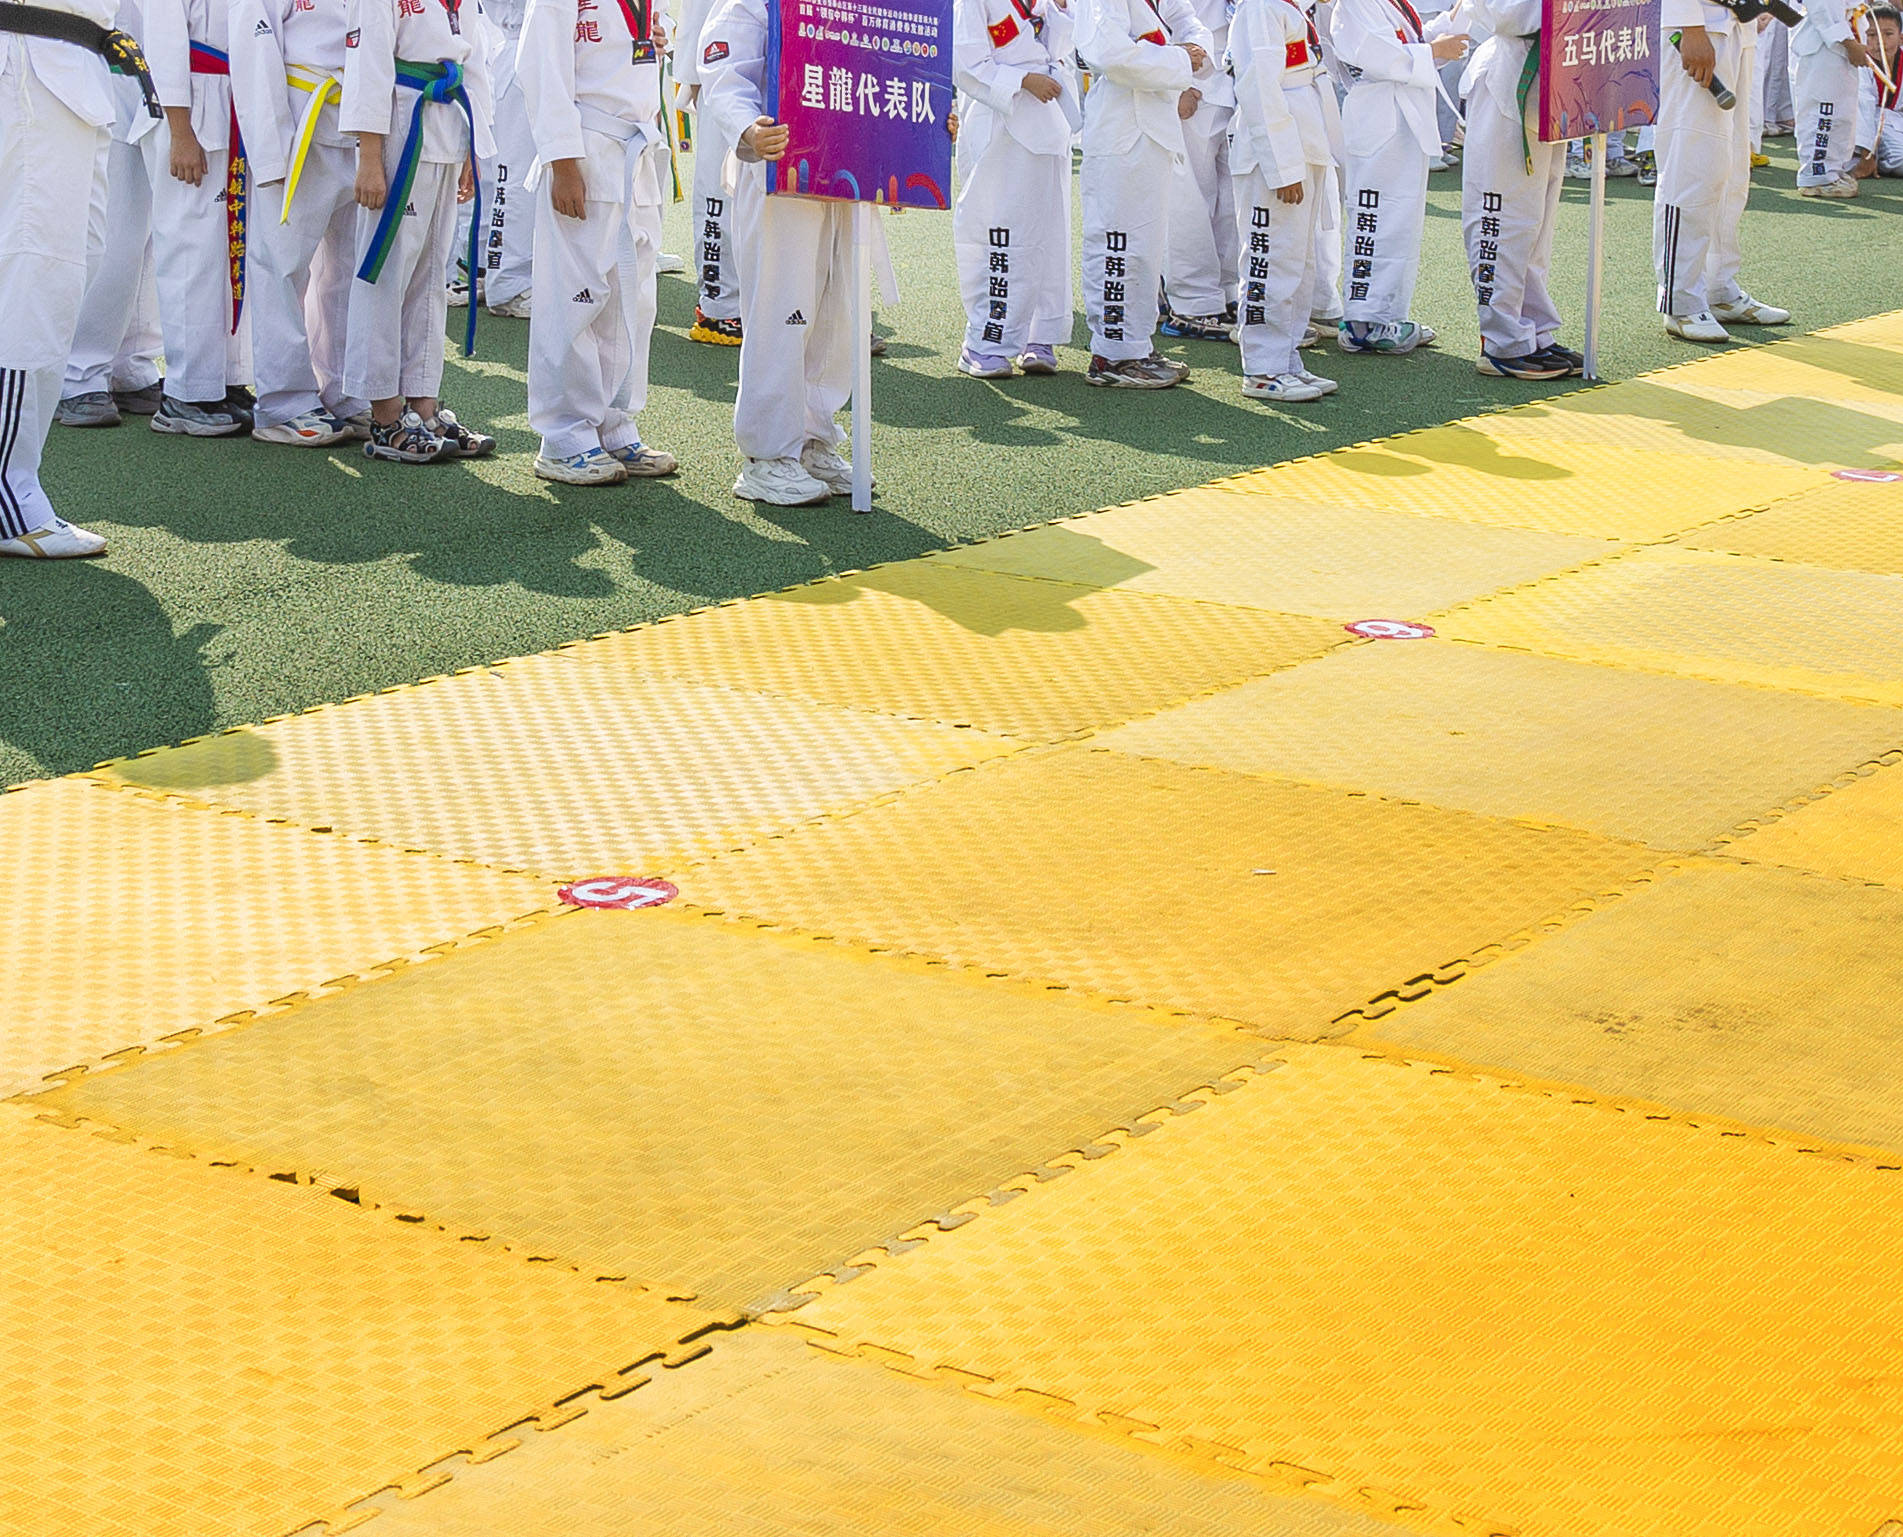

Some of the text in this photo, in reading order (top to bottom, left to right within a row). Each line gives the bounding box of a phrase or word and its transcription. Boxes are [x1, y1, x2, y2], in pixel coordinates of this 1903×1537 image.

[801, 63, 936, 125] 星龍代表队
[1562, 24, 1650, 67] 五马代表队
[982, 227, 1010, 344] 中韩跆拳道
[1245, 206, 1270, 326] 中韩跆拳道
[1349, 189, 1379, 301] 中韩跆拳道
[1478, 192, 1502, 306] 中韩跆拳道
[571, 881, 669, 909] 5
